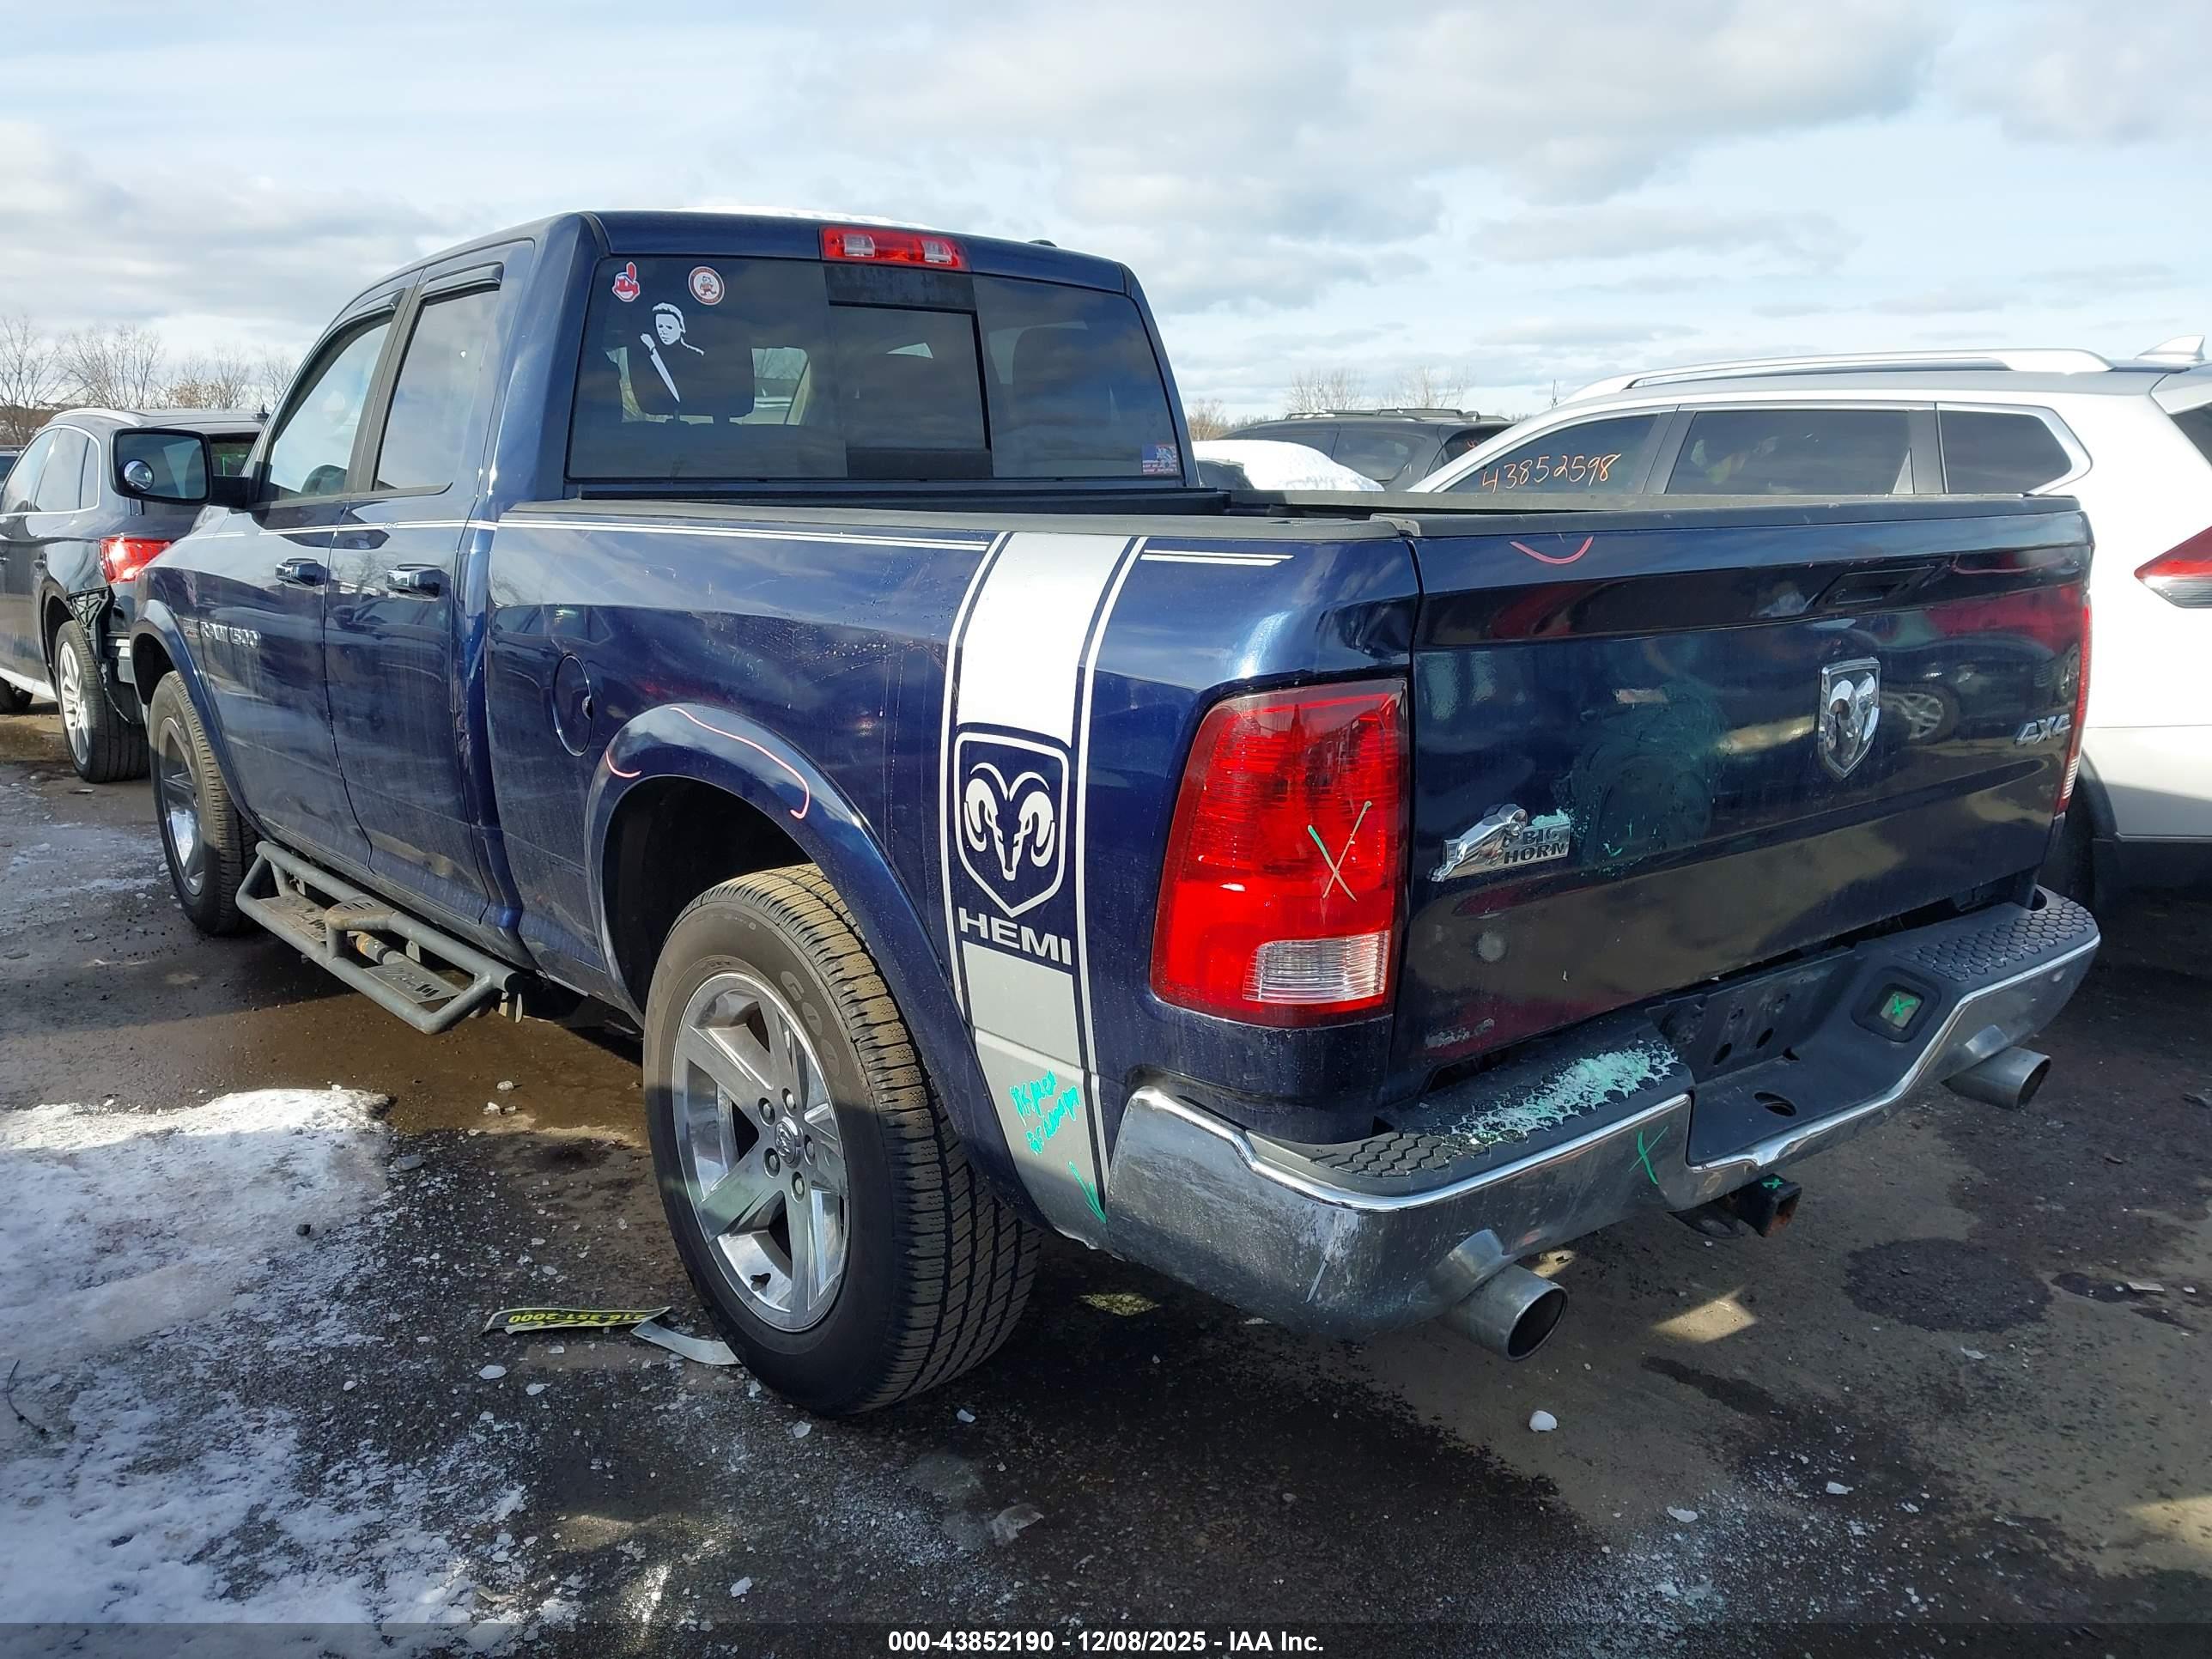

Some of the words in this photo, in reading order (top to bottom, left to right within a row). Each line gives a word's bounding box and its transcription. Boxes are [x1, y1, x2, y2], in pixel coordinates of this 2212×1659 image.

[1482, 453, 1622, 495] 43852598
[1522, 827, 1561, 844] BIG
[1504, 842, 1565, 864] HORN
[957, 906, 1073, 966] HEMI
